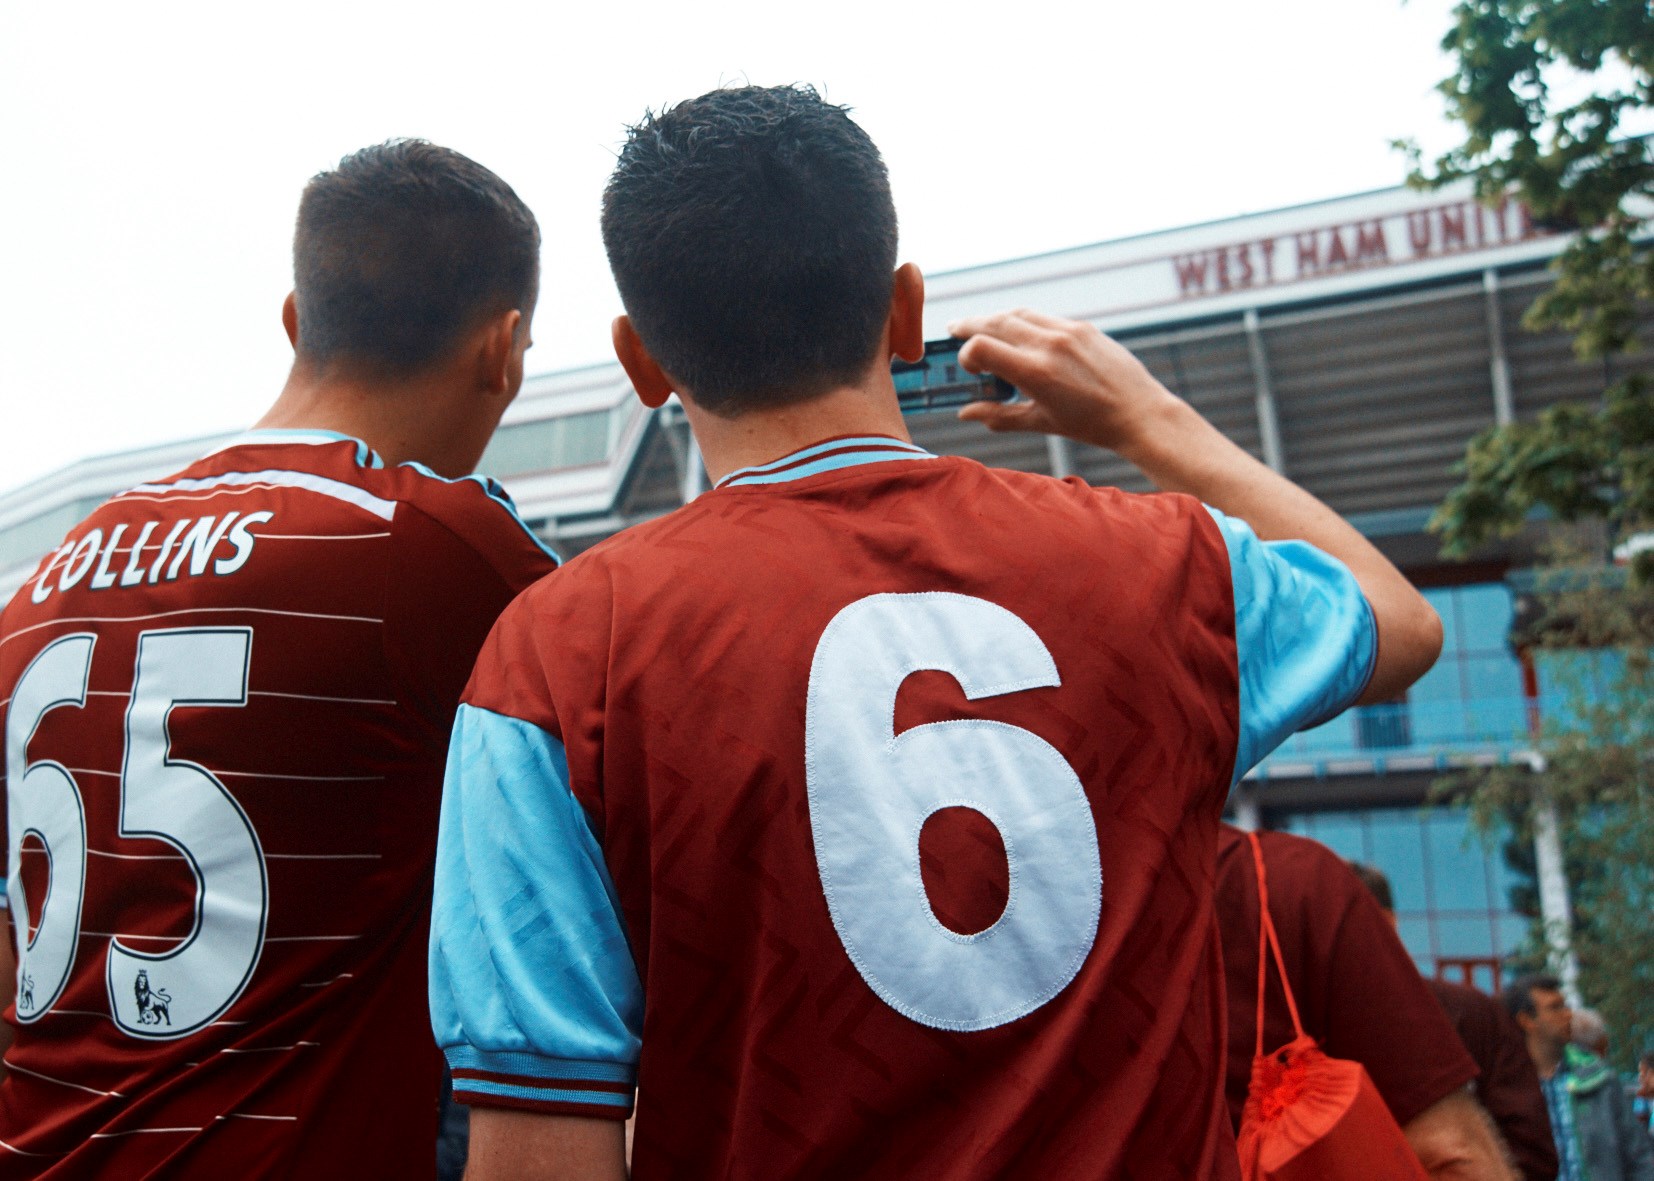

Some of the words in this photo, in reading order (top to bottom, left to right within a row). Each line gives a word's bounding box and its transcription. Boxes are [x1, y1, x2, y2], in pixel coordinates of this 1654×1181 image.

[1174, 236, 1274, 298] WEST
[1297, 217, 1387, 279] HAM
[31, 511, 274, 604] COLLINS
[6, 626, 269, 1041] 65
[805, 591, 1102, 1032] 6
